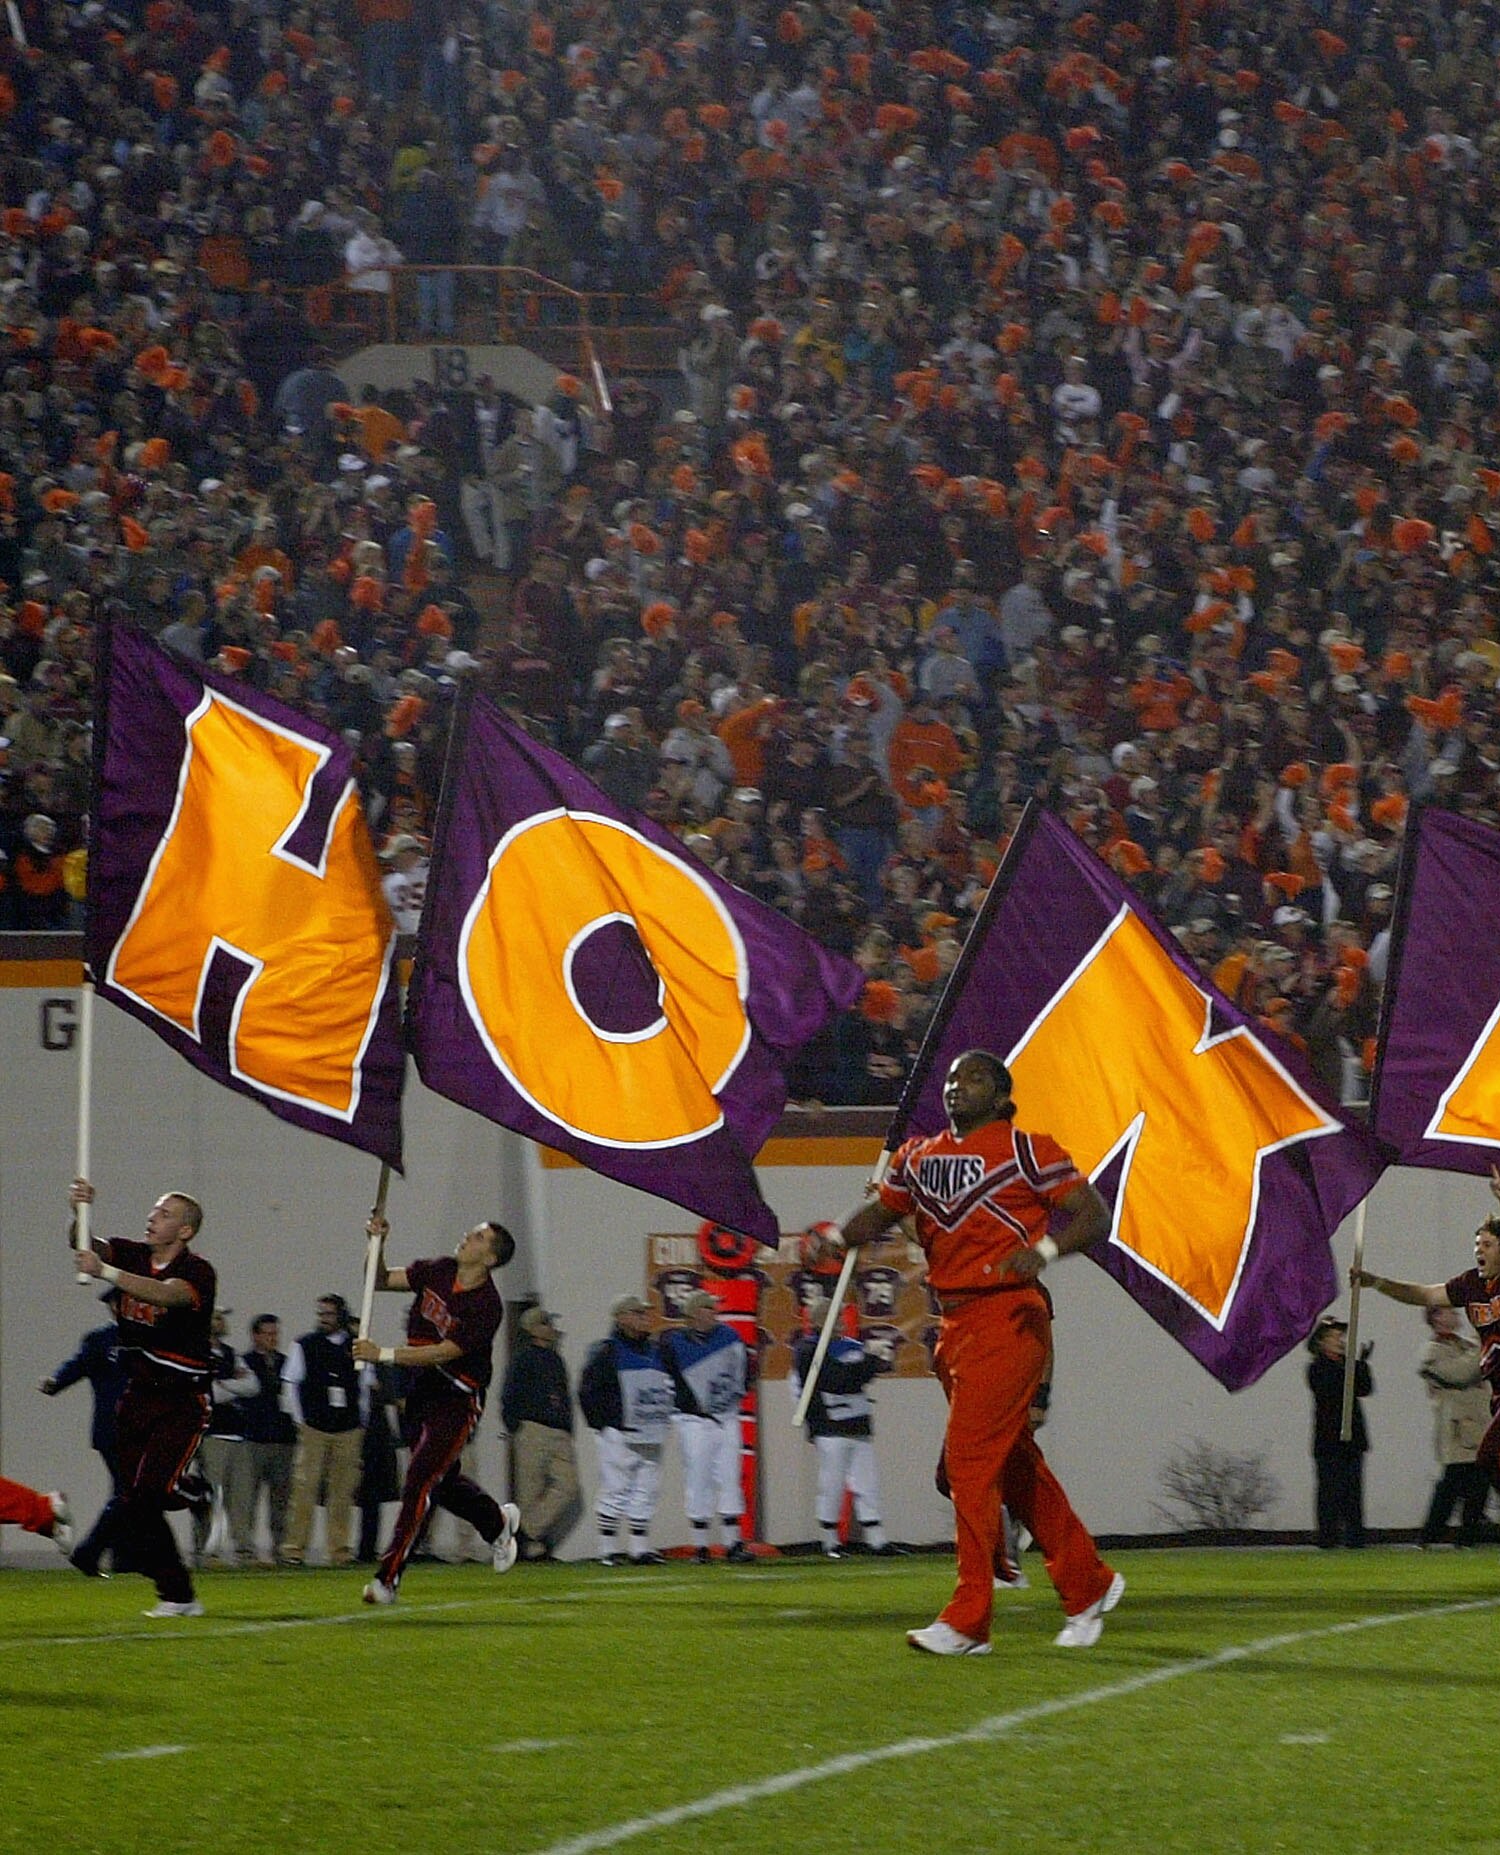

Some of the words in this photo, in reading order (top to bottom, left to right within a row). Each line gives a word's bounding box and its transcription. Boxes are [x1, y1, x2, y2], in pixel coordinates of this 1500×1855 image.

[43, 998, 78, 1051] G
[106, 685, 399, 1123] H
[457, 805, 751, 1150] O
[919, 1156, 983, 1200] HOKIES
[1004, 901, 1345, 1333] K
